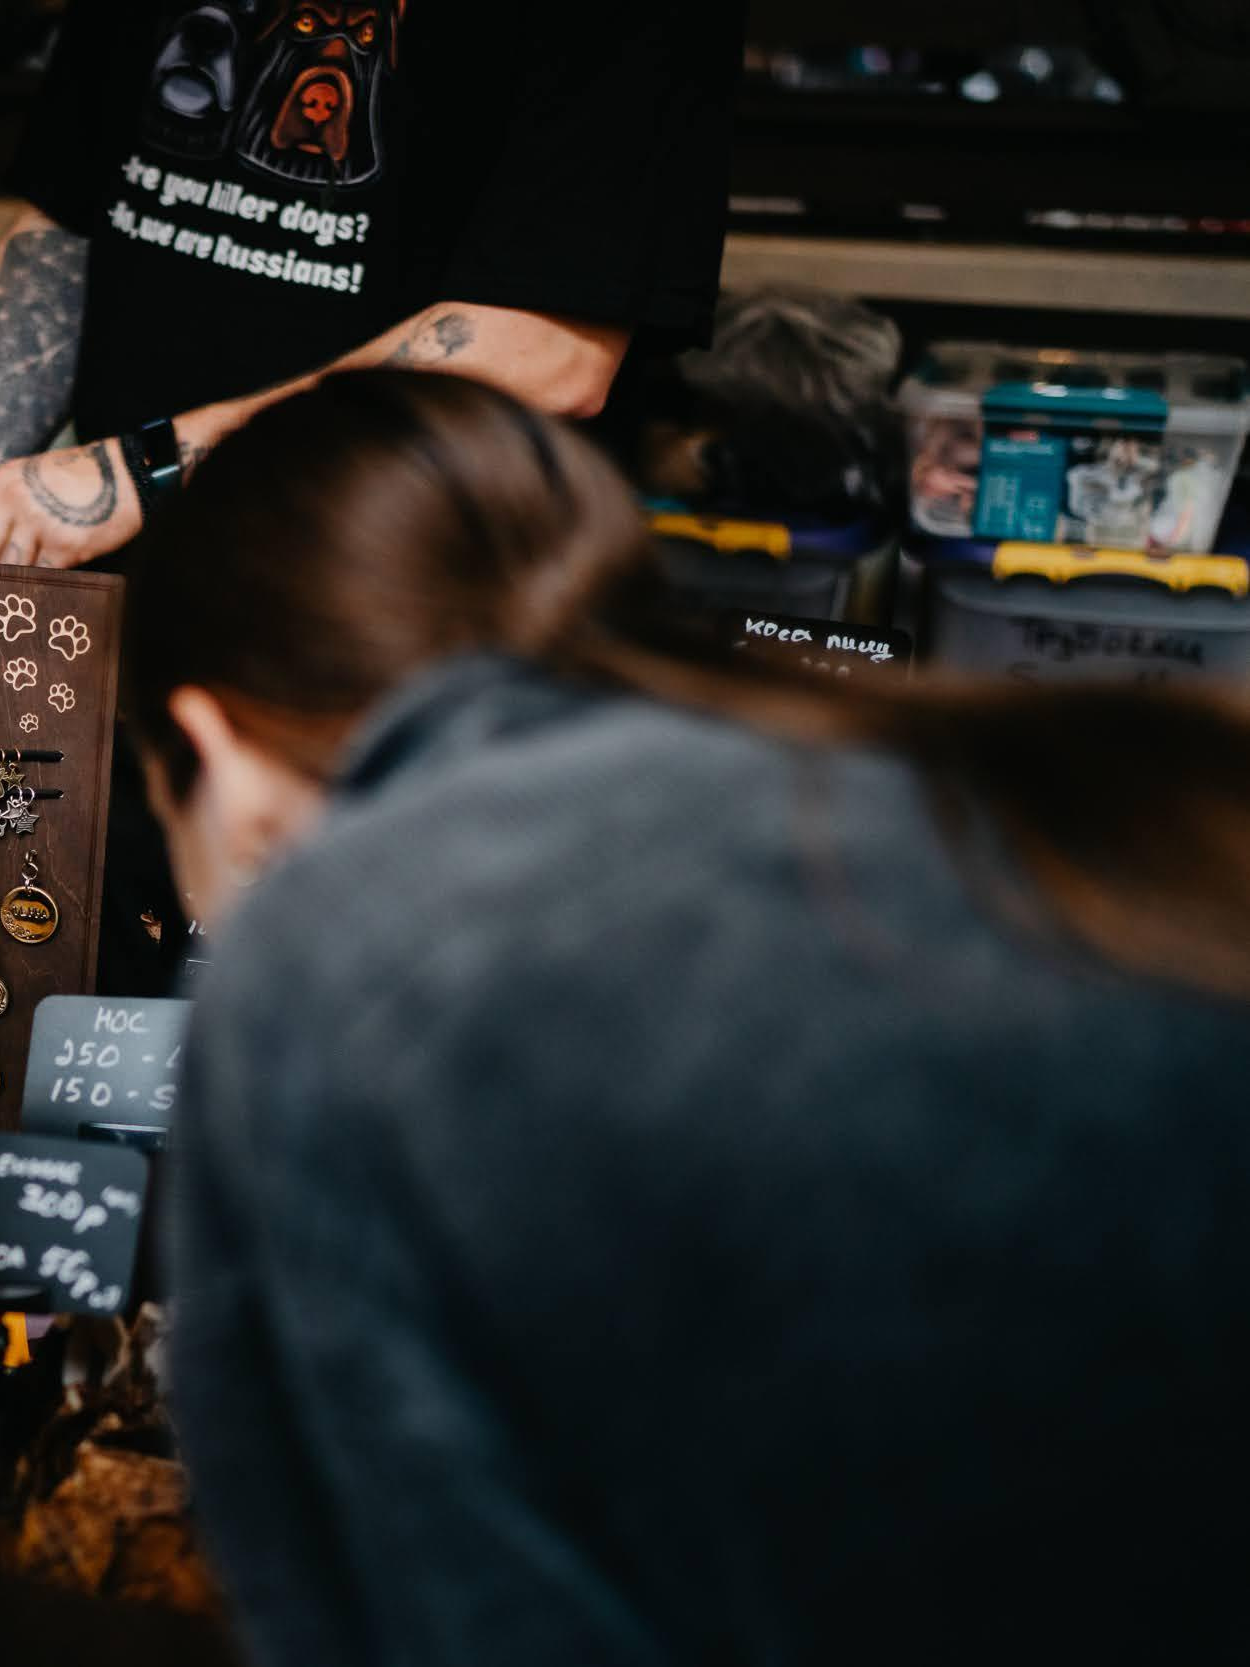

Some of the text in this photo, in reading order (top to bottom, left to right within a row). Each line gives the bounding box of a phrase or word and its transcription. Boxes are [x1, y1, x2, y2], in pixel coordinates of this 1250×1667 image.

[279, 200, 370, 247] dogs?
[213, 234, 364, 294] Russians!
[54, 1038, 120, 1068] 250
[51, 1077, 111, 1107] 150
